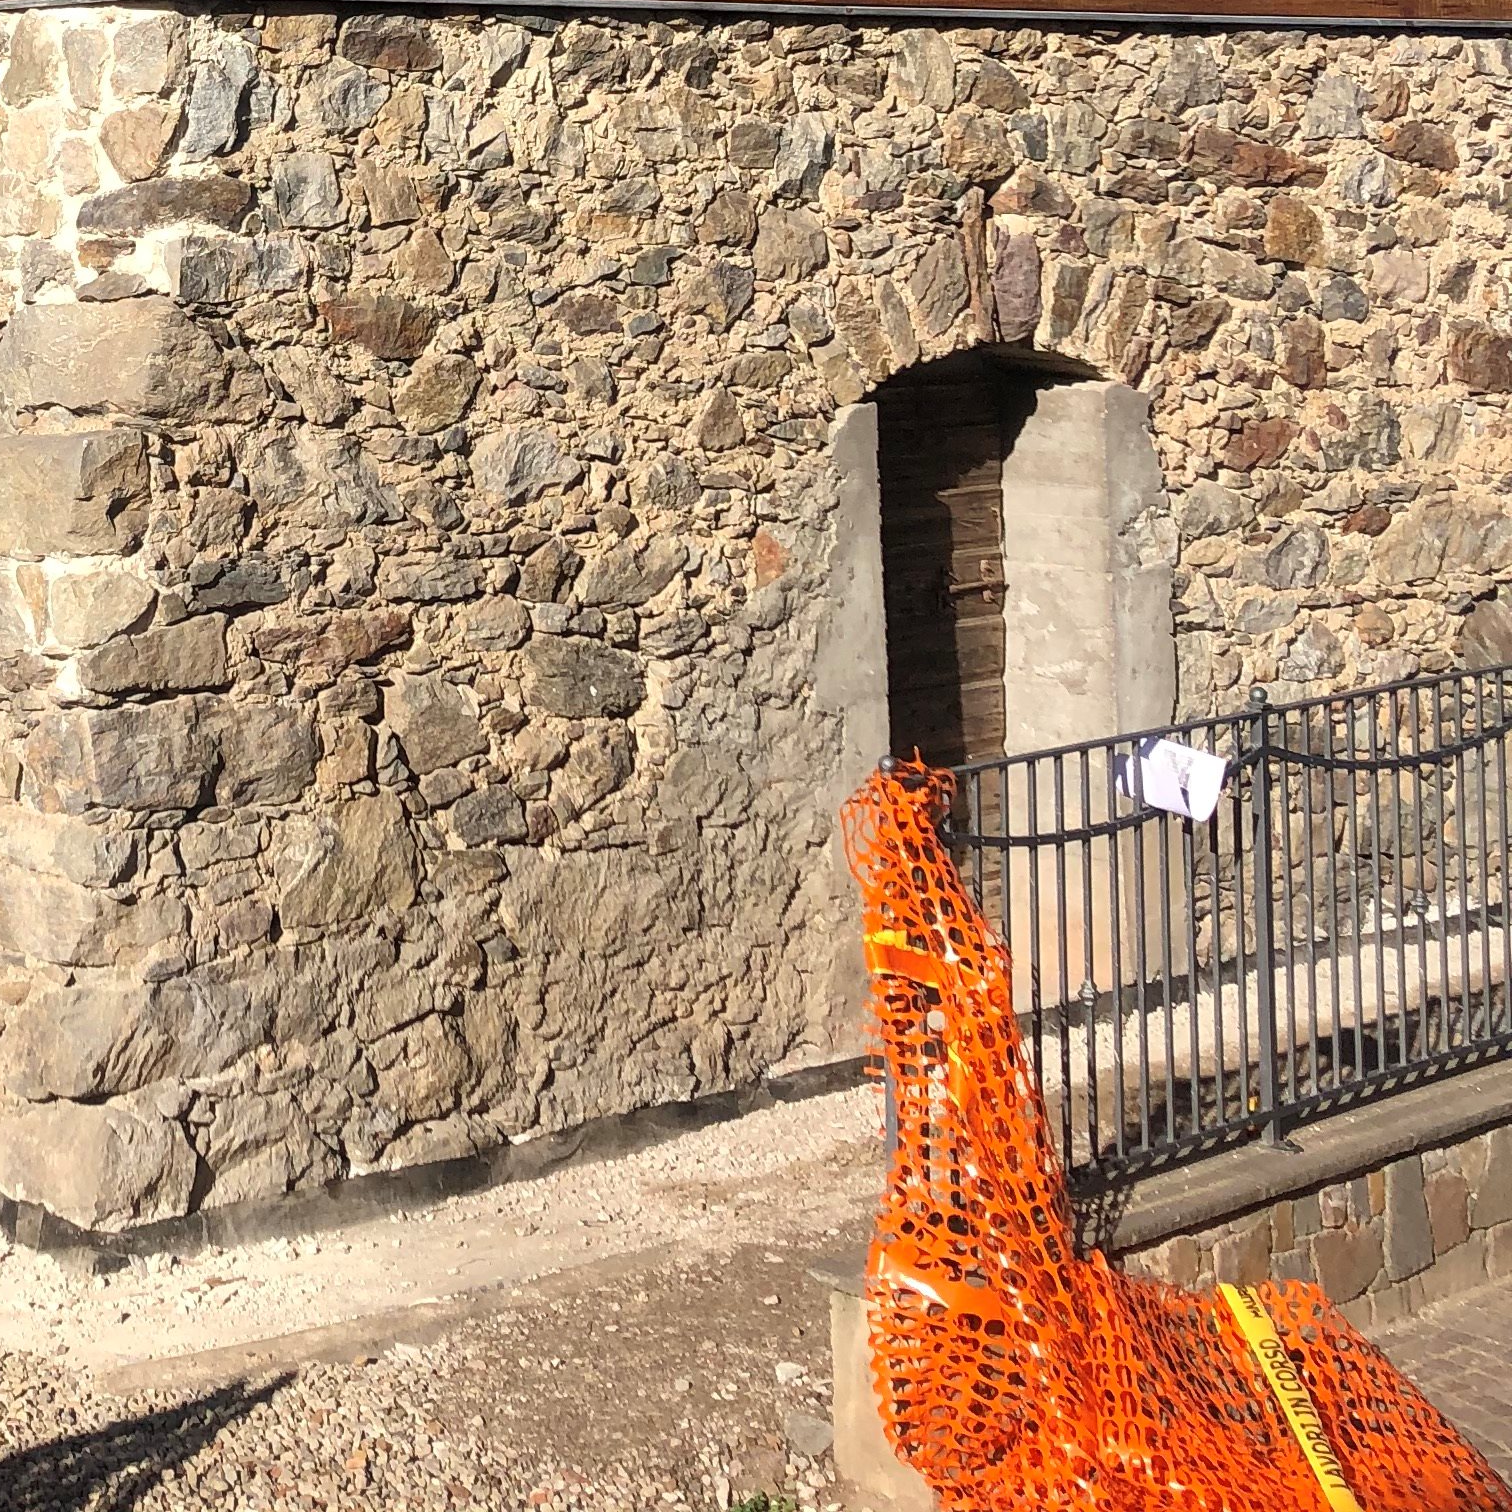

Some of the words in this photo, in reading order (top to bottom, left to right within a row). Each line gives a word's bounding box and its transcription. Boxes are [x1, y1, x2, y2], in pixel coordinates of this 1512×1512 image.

[1259, 1338, 1304, 1393] CORSO
[1287, 1397, 1317, 1419] IN
[1299, 1421, 1352, 1494] LAVORI
